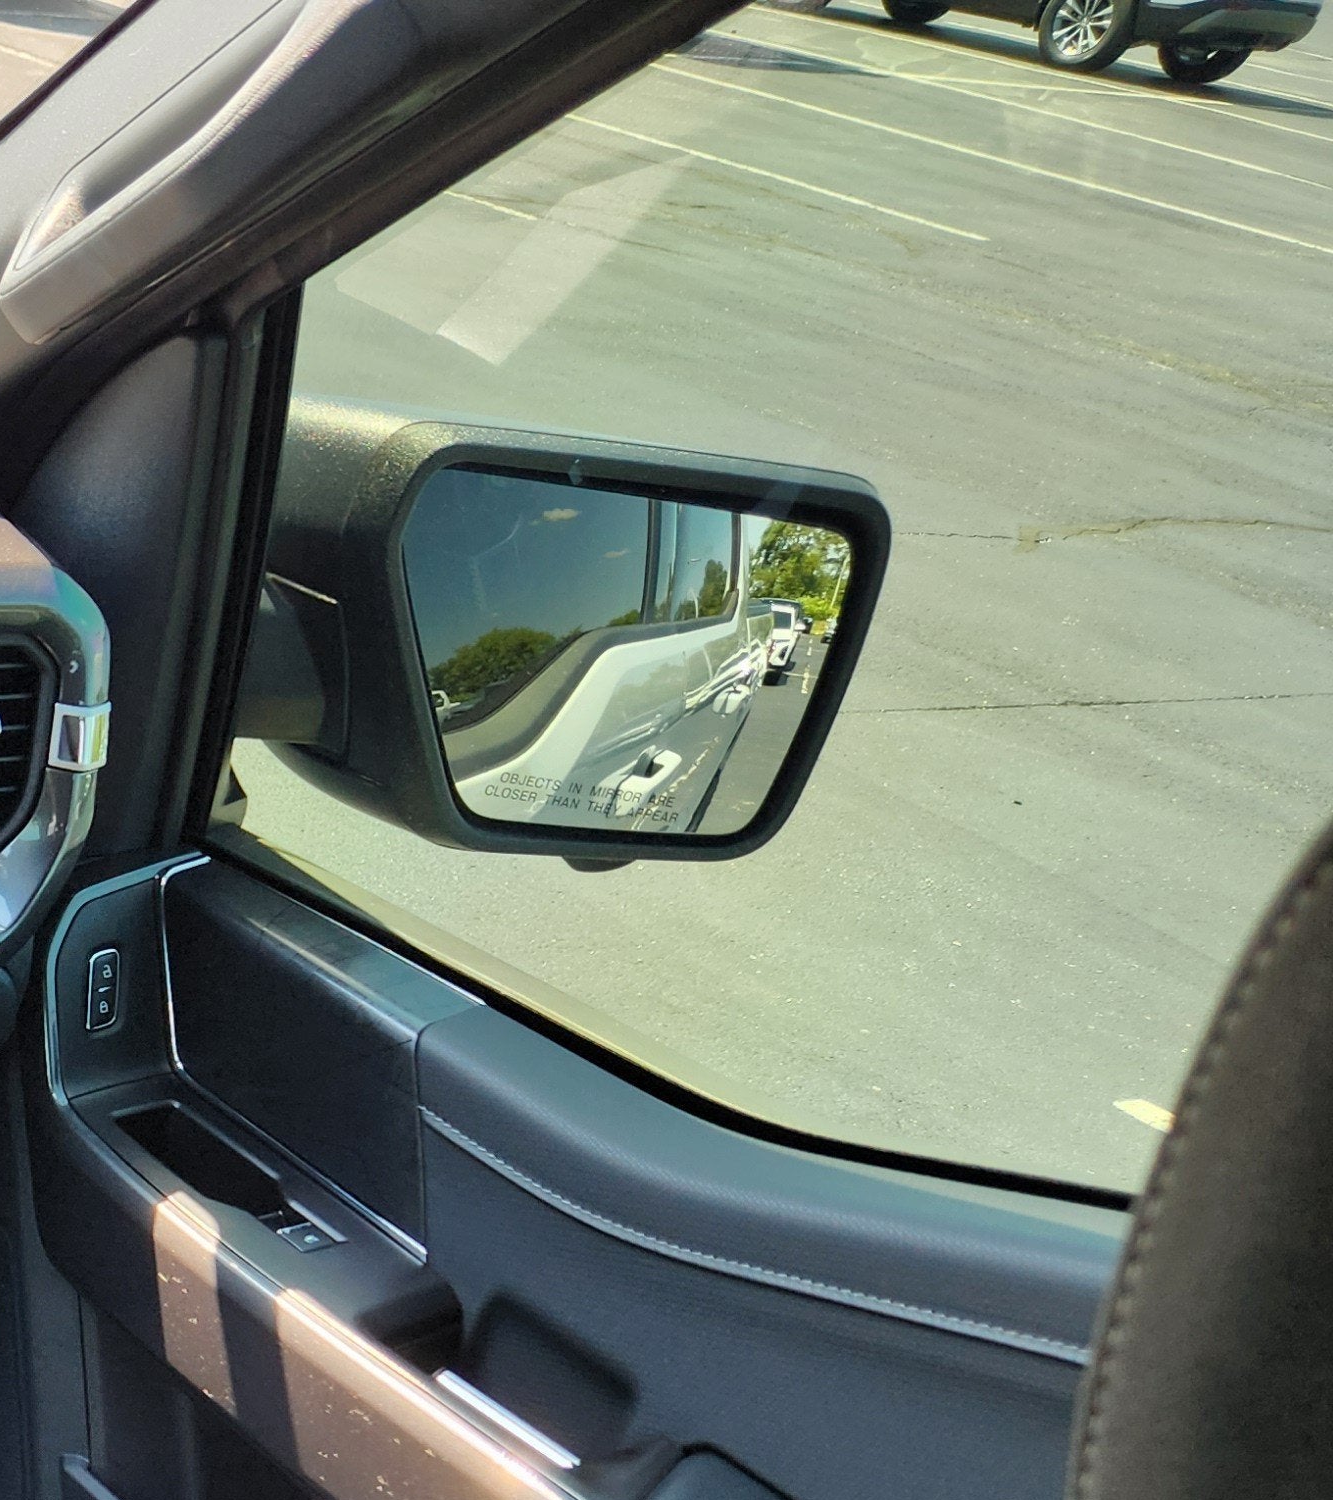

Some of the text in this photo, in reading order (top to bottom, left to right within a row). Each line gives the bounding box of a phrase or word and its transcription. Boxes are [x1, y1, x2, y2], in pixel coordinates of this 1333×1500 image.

[484, 784, 680, 823] CLOSER THAN THEY APPEAR
[500, 771, 677, 808] OBJECTS IN MIRROR ARE
